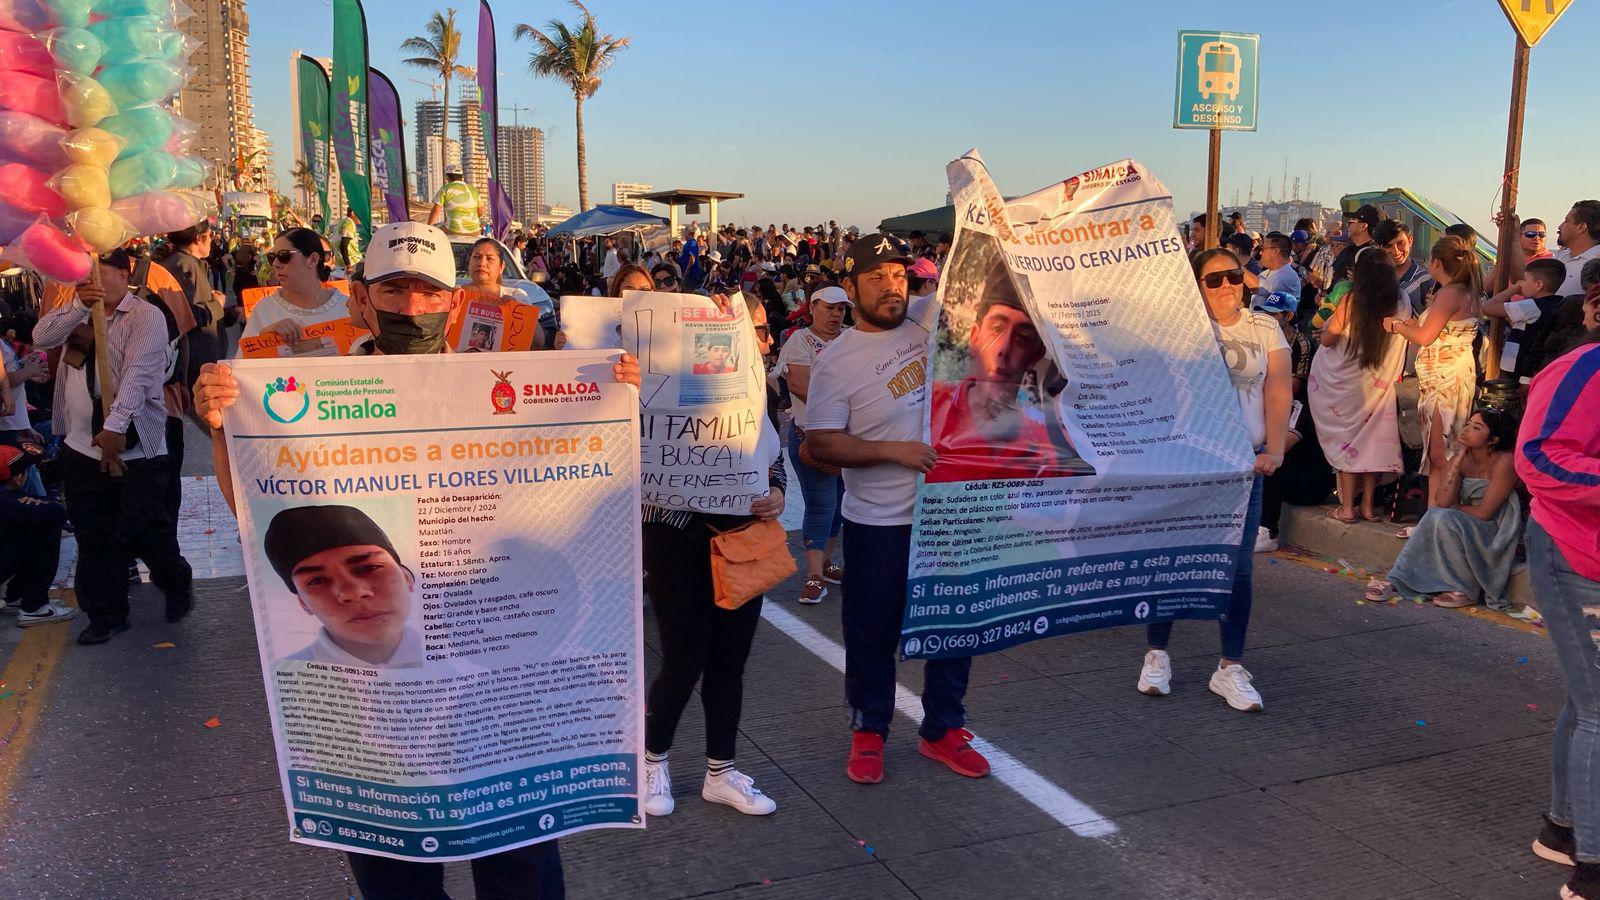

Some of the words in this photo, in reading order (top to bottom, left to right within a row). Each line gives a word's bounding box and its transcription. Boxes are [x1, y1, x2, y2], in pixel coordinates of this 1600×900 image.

[1192, 104, 1235, 112] ASCENSO
[1193, 114, 1241, 124] DESCENSO
[1026, 219, 1130, 247] encontrar
[1140, 214, 1155, 231] a
[874, 238, 892, 255] A
[1079, 237, 1181, 269] CERVANTES
[1071, 297, 1111, 308] Desaparición:
[682, 309, 701, 318] SE
[315, 378, 349, 386] Comisión
[523, 382, 600, 396] SINALOA
[316, 388, 350, 398] Búsqueda
[318, 399, 397, 420] Sinaloa
[665, 409, 756, 441] FAMILIA
[276, 444, 417, 474] Ayúdanos
[426, 444, 442, 462] a
[451, 435, 584, 460] encontrar
[588, 434, 602, 452] a
[256, 476, 326, 495] VÍCTOR
[334, 473, 422, 494] MANUEL
[428, 470, 498, 489] FLORES
[503, 462, 613, 484] VILLARREAL
[669, 471, 759, 488] ERNESTO
[992, 480, 1044, 489] RZS-0089-2025
[452, 492, 502, 502] Desaparición:
[421, 559, 454, 568] Estatura:
[422, 578, 468, 589] Complexión:
[470, 576, 499, 584] Delgado
[912, 584, 926, 598] Si
[933, 583, 980, 596] tienes
[985, 567, 1062, 591] información
[1068, 560, 1125, 577] referente
[1130, 559, 1138, 569] a
[1144, 555, 1170, 567] esta
[1174, 553, 1233, 567] persona,
[910, 604, 950, 618] llama
[956, 604, 966, 614] o
[970, 588, 1041, 613] escribenos.
[1046, 584, 1061, 596] Tu
[1064, 580, 1103, 596] ayuda
[1106, 578, 1121, 588] es
[1124, 574, 1151, 586] muy
[1154, 568, 1229, 583] importante.
[425, 631, 451, 640] Frente:
[453, 628, 484, 637] Pequeña
[426, 642, 446, 650] Boca:
[448, 639, 481, 647] Mediana,
[504, 631, 538, 639] medianos
[943, 635, 979, 650] (669)
[982, 627, 1002, 644] 327
[1004, 620, 1031, 637] 8424
[296, 776, 310, 788] Si
[316, 779, 352, 795] tienes
[358, 786, 440, 804] información
[448, 781, 512, 802] referente
[519, 777, 527, 787] a
[534, 770, 563, 783] esta
[570, 760, 630, 779] persona,
[299, 792, 332, 806] llama
[336, 800, 343, 808] o
[348, 802, 422, 820] escribenos.
[428, 808, 445, 820] Tu
[450, 798, 494, 820] ayuda
[497, 797, 514, 808] es
[518, 788, 548, 803] muy
[552, 775, 631, 795] importante.
[358, 830, 376, 842] 327
[378, 835, 405, 848] 8424
